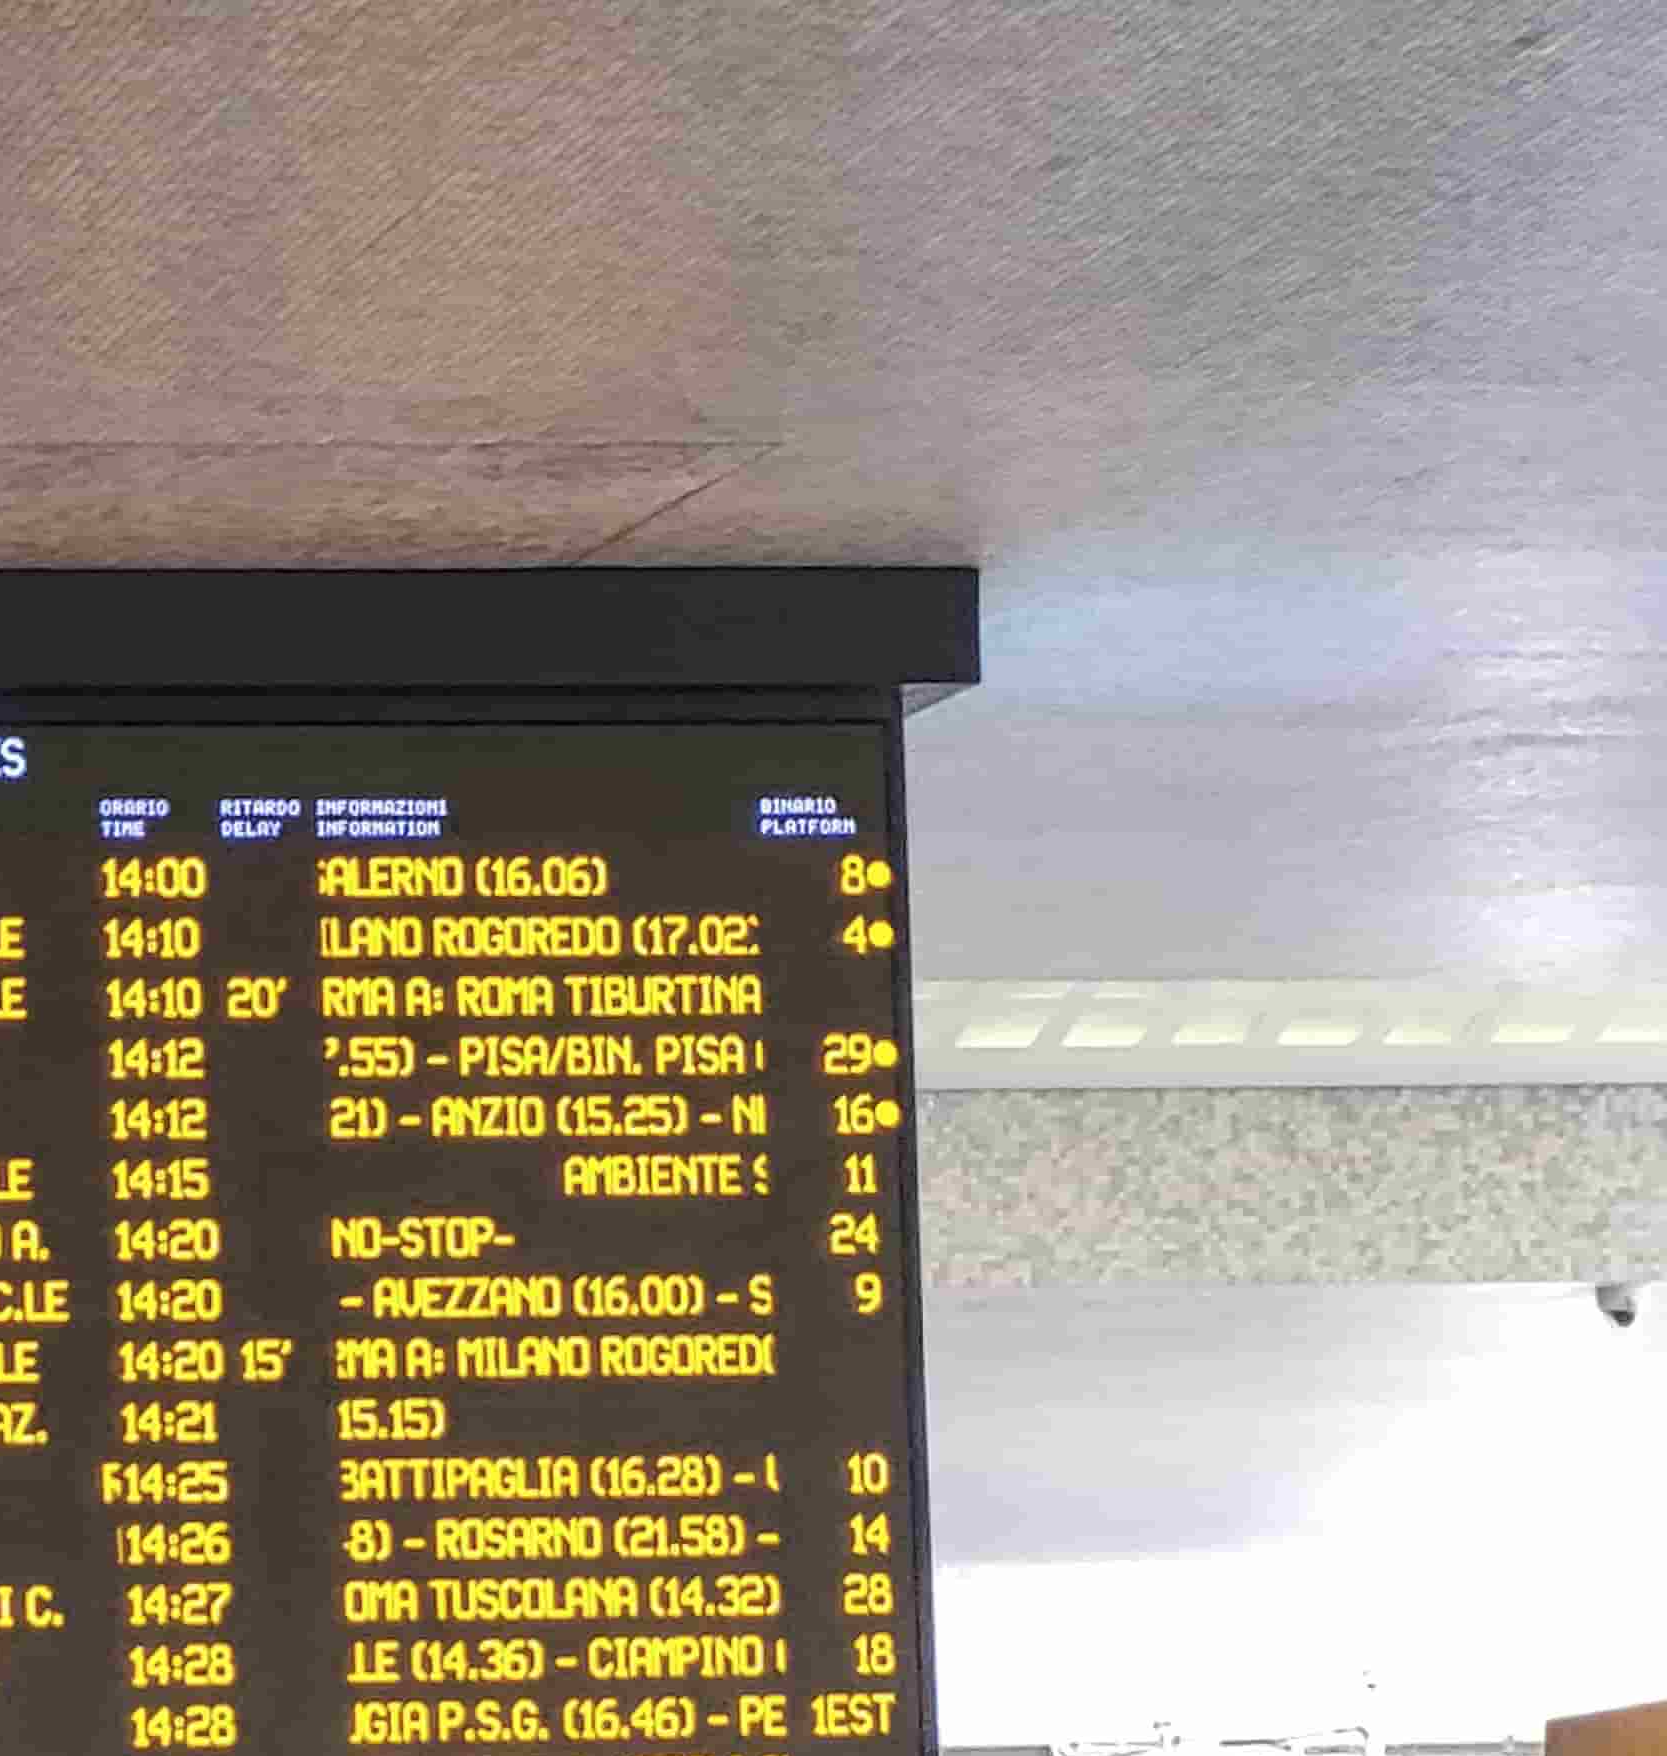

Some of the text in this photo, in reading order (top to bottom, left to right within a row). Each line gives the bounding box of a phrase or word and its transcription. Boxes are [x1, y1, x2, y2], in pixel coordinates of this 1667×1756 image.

[99, 799, 169, 816] ORARIO
[220, 799, 301, 816] RITARDO
[316, 799, 448, 816] INFORMAZIONI
[760, 797, 837, 814] BINARIO
[101, 820, 145, 837] TIME
[221, 820, 281, 836] DELAY
[317, 819, 441, 836] INFORMATION
[760, 818, 856, 835] PLATFORM
[103, 858, 205, 897] 14:00
[477, 857, 606, 896] (16.06)
[104, 918, 199, 957] 14:10
[434, 917, 620, 956] ROGOREDO
[107, 978, 201, 1018] 14:10
[457, 976, 553, 1016] ROMA
[564, 976, 761, 1016] TIBURTINA
[109, 1038, 203, 1078] 14:12
[460, 1036, 641, 1075] PISA/BIN.
[657, 1035, 744, 1074] PISA
[824, 1034, 872, 1073] 29
[112, 1099, 206, 1138] 14:12
[433, 1096, 544, 1136] ANZIO
[557, 1096, 687, 1135] (15.25)
[835, 1094, 875, 1133] 16
[113, 1159, 208, 1198] 14:15
[565, 1155, 741, 1195] AMBIENTE
[846, 1155, 876, 1192] 11
[13, 1221, 48, 1260] A.
[115, 1219, 219, 1259] 14:20
[332, 1217, 513, 1257] NO-STOP-
[831, 1214, 878, 1253] 24
[118, 1280, 221, 1320] 14:20
[374, 1277, 561, 1317] AVEZZANO
[574, 1276, 703, 1315] (16.00)
[856, 1274, 881, 1312] 9
[120, 1341, 223, 1380] 14:20
[458, 1336, 590, 1377] MILANO
[122, 1402, 216, 1442] 14:21
[123, 1462, 227, 1502] 14:25
[591, 1456, 720, 1496] (16.28)
[849, 1454, 887, 1493] 10
[126, 1523, 230, 1563] 14:26
[437, 1518, 602, 1559] ROSARNO
[615, 1515, 744, 1556] (21.58)
[851, 1514, 889, 1554] 14
[26, 1586, 63, 1626] C.
[128, 1583, 231, 1624] 14:27
[429, 1578, 637, 1620] TUSCOLANA
[650, 1576, 779, 1616] (14.32)
[844, 1574, 892, 1613] 28
[130, 1644, 233, 1686] 14:28
[412, 1640, 543, 1680] (14.36)
[589, 1636, 763, 1678] CIAMPINO
[855, 1634, 895, 1674] 18
[131, 1705, 235, 1747] 14:28
[439, 1700, 549, 1741] P.S.G.
[564, 1698, 694, 1739] (16.46)
[812, 1694, 895, 1735] 1EST
